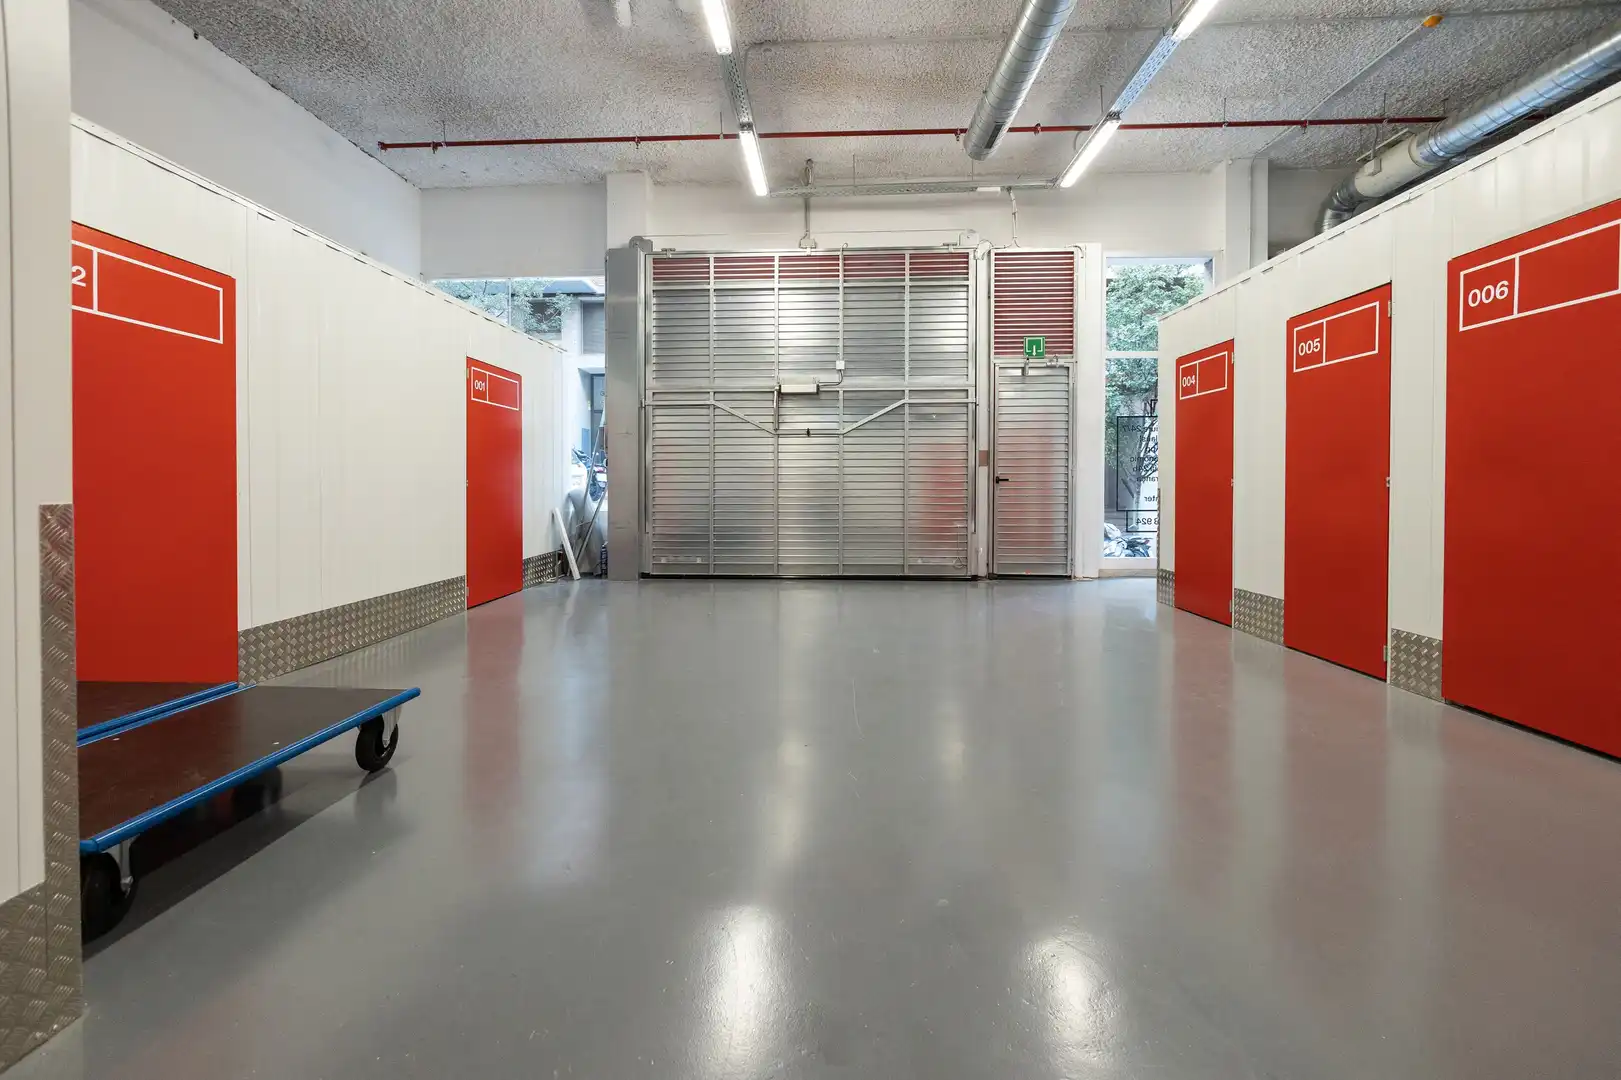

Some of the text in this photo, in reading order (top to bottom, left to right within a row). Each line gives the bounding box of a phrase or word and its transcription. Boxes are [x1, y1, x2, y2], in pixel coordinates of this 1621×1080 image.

[1468, 280, 1509, 307] 006
[1298, 338, 1321, 356] 005
[474, 379, 486, 391] 001
[1182, 375, 1196, 387] 004
